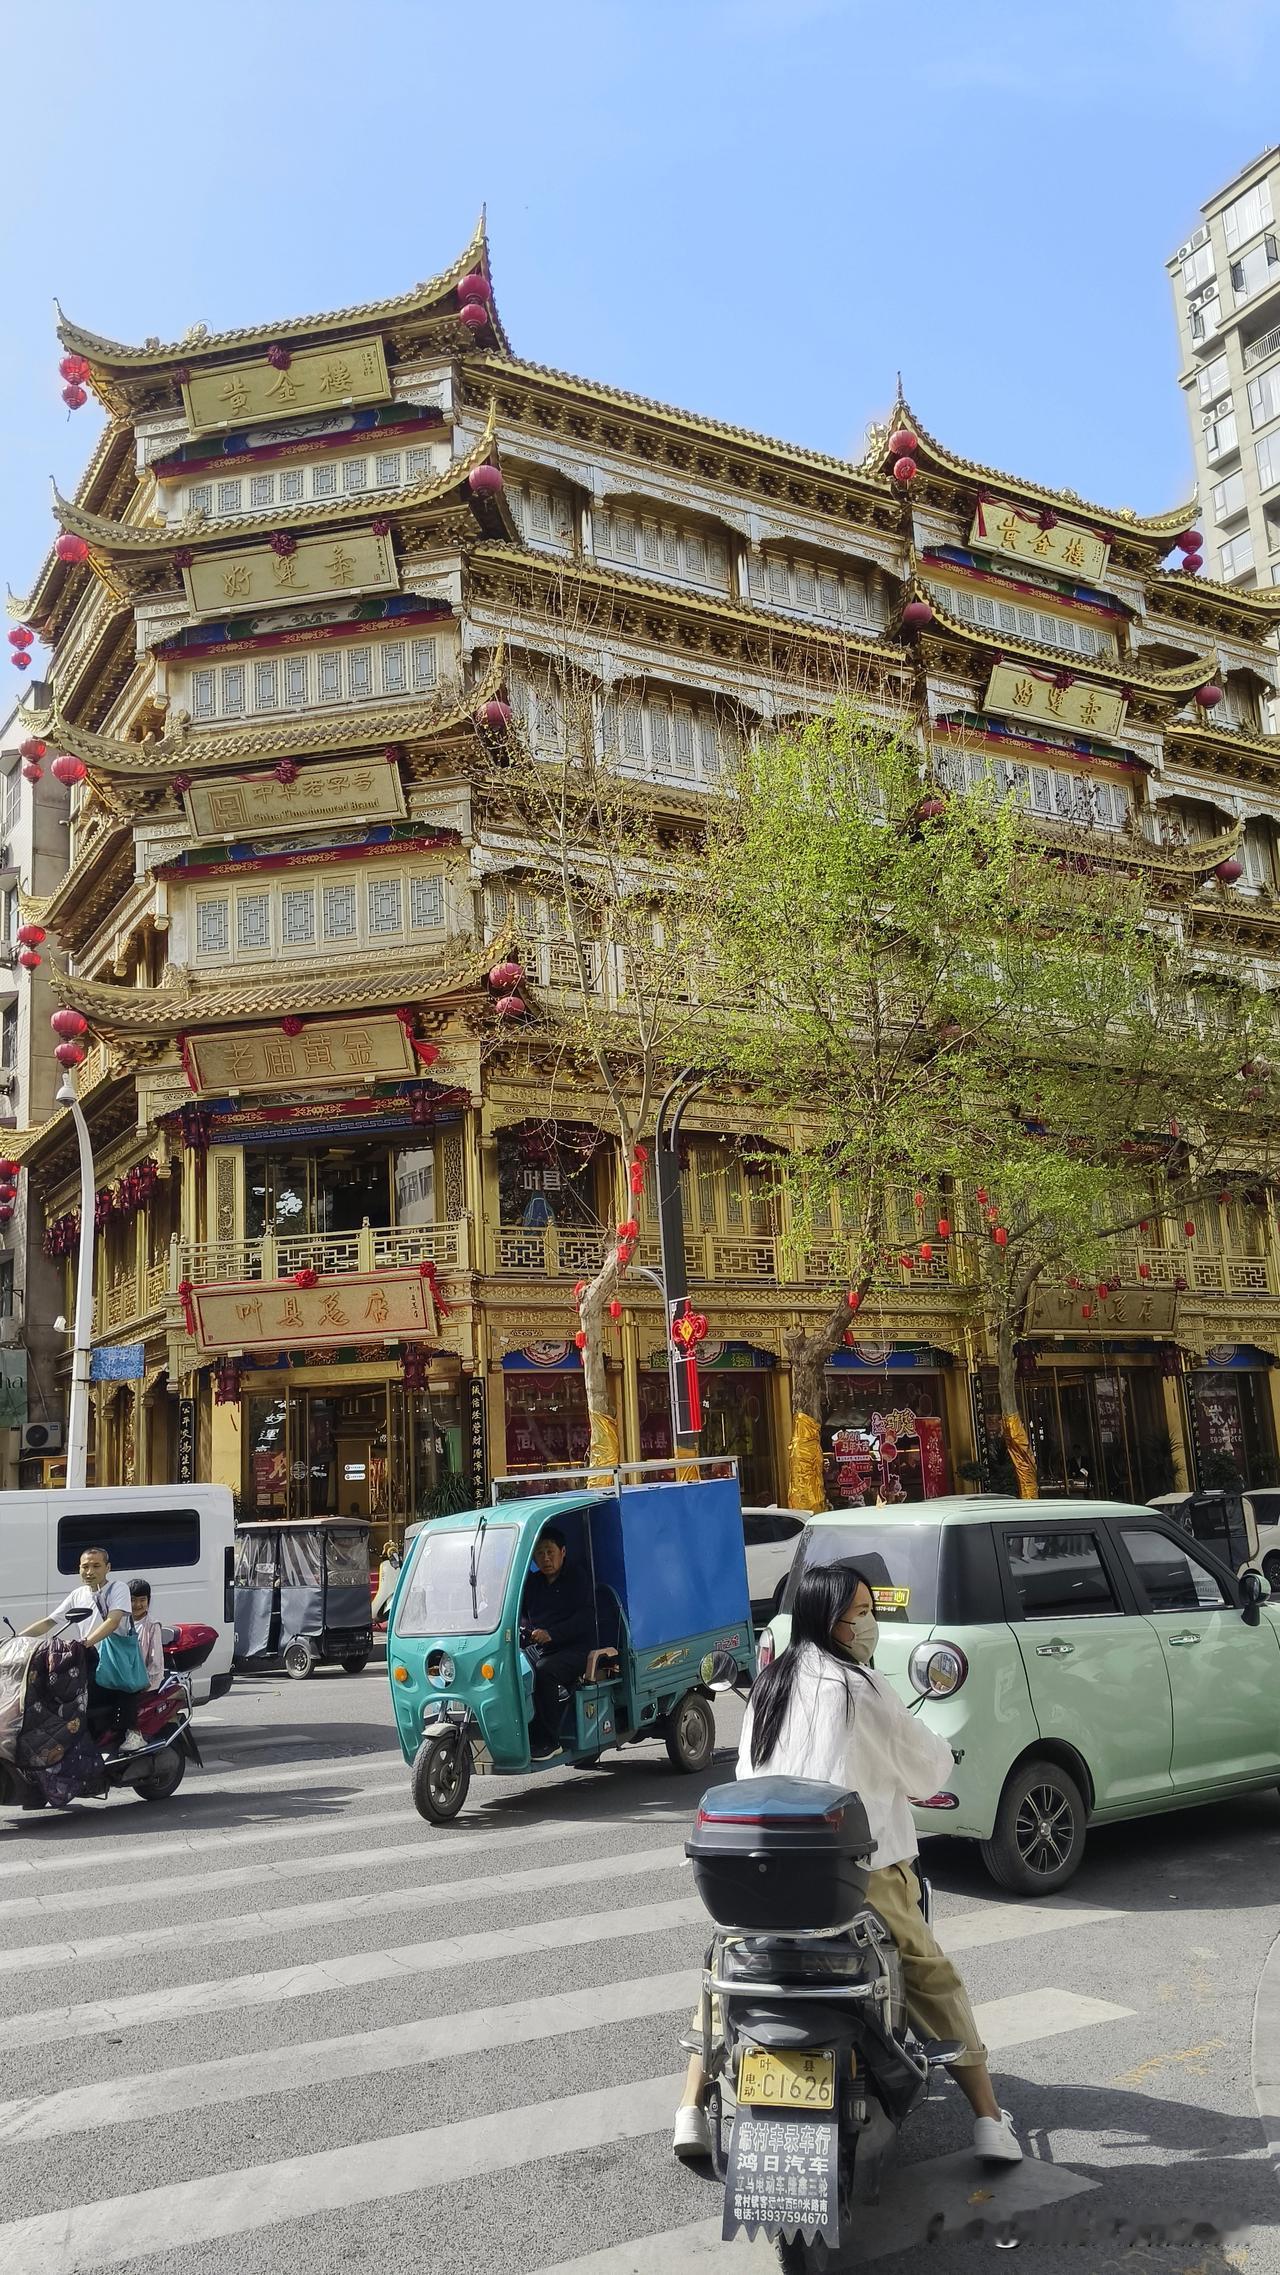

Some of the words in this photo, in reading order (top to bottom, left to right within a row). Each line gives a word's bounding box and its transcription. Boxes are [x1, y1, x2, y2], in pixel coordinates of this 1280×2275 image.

[252, 771, 376, 804] 中华老字号
[223, 1030, 378, 1081] 老庙黄金
[233, 1287, 392, 1336] 叶县总店
[181, 1406, 193, 1484] 公平交易生意
[470, 1385, 484, 1510] 诚信经营财源
[736, 2152, 829, 2176] 鸿日汽车
